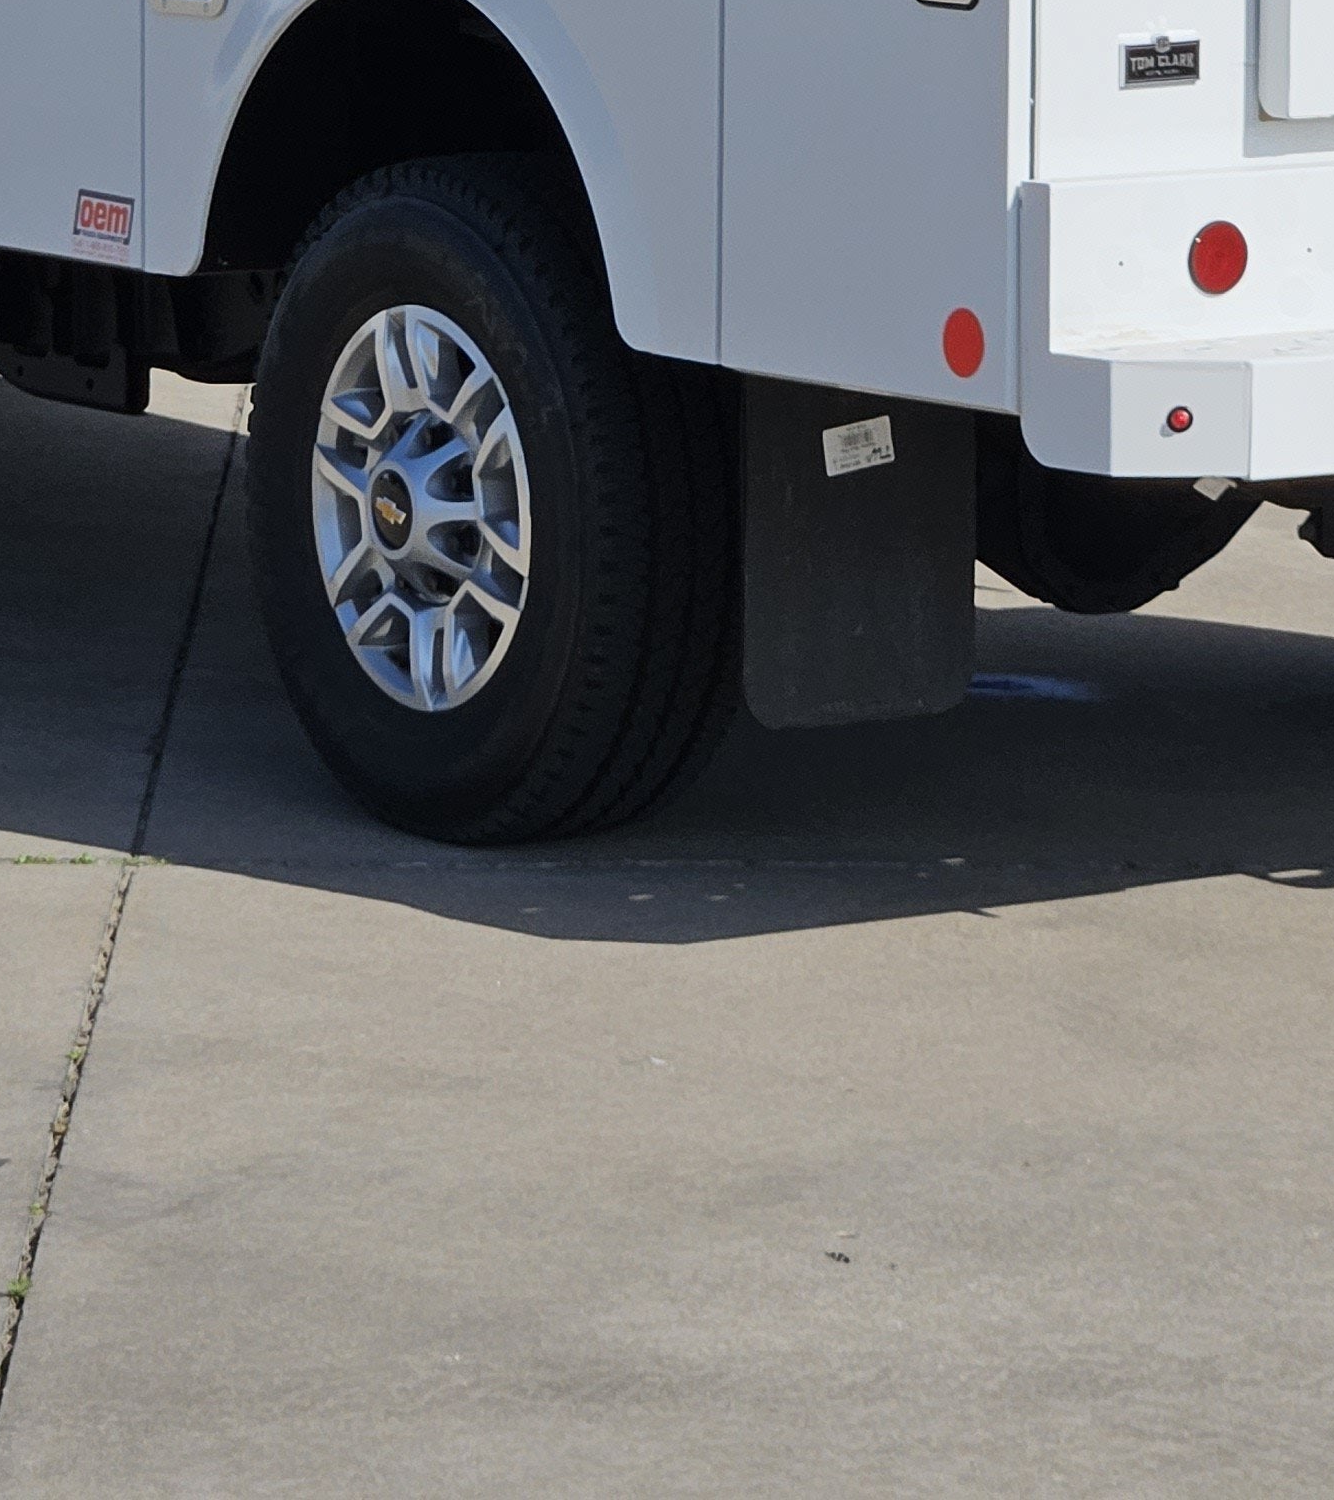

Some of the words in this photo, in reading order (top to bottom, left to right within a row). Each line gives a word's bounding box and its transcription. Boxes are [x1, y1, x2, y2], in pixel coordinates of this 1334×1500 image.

[1130, 55, 1155, 72] TOM
[1157, 52, 1194, 68] CLARK
[80, 200, 128, 235] oem
